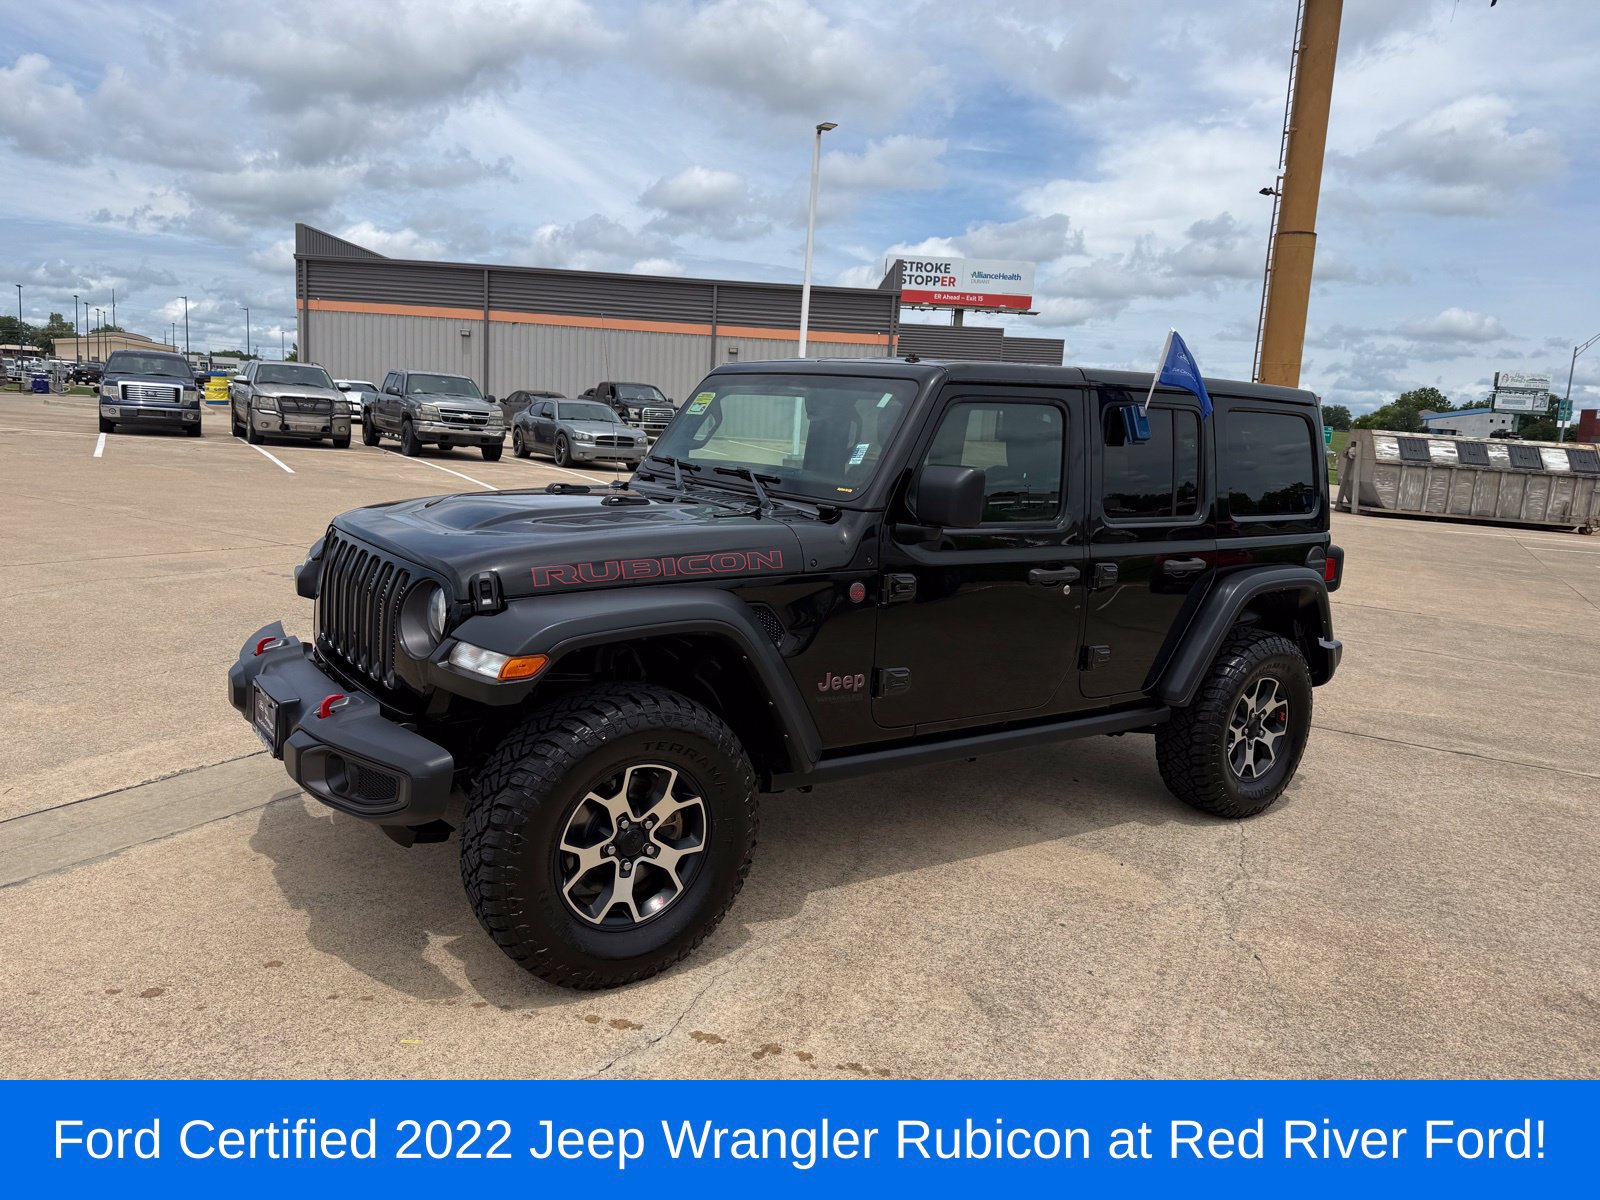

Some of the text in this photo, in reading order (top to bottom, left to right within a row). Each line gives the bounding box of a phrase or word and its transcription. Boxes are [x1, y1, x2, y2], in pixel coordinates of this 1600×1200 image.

[902, 261, 951, 273] STROKE
[902, 274, 956, 287] STOPPER
[971, 271, 1022, 280] AllianceHealth
[965, 294, 977, 302] Exit
[531, 550, 784, 588] RUBICON
[817, 671, 866, 692] Jeep
